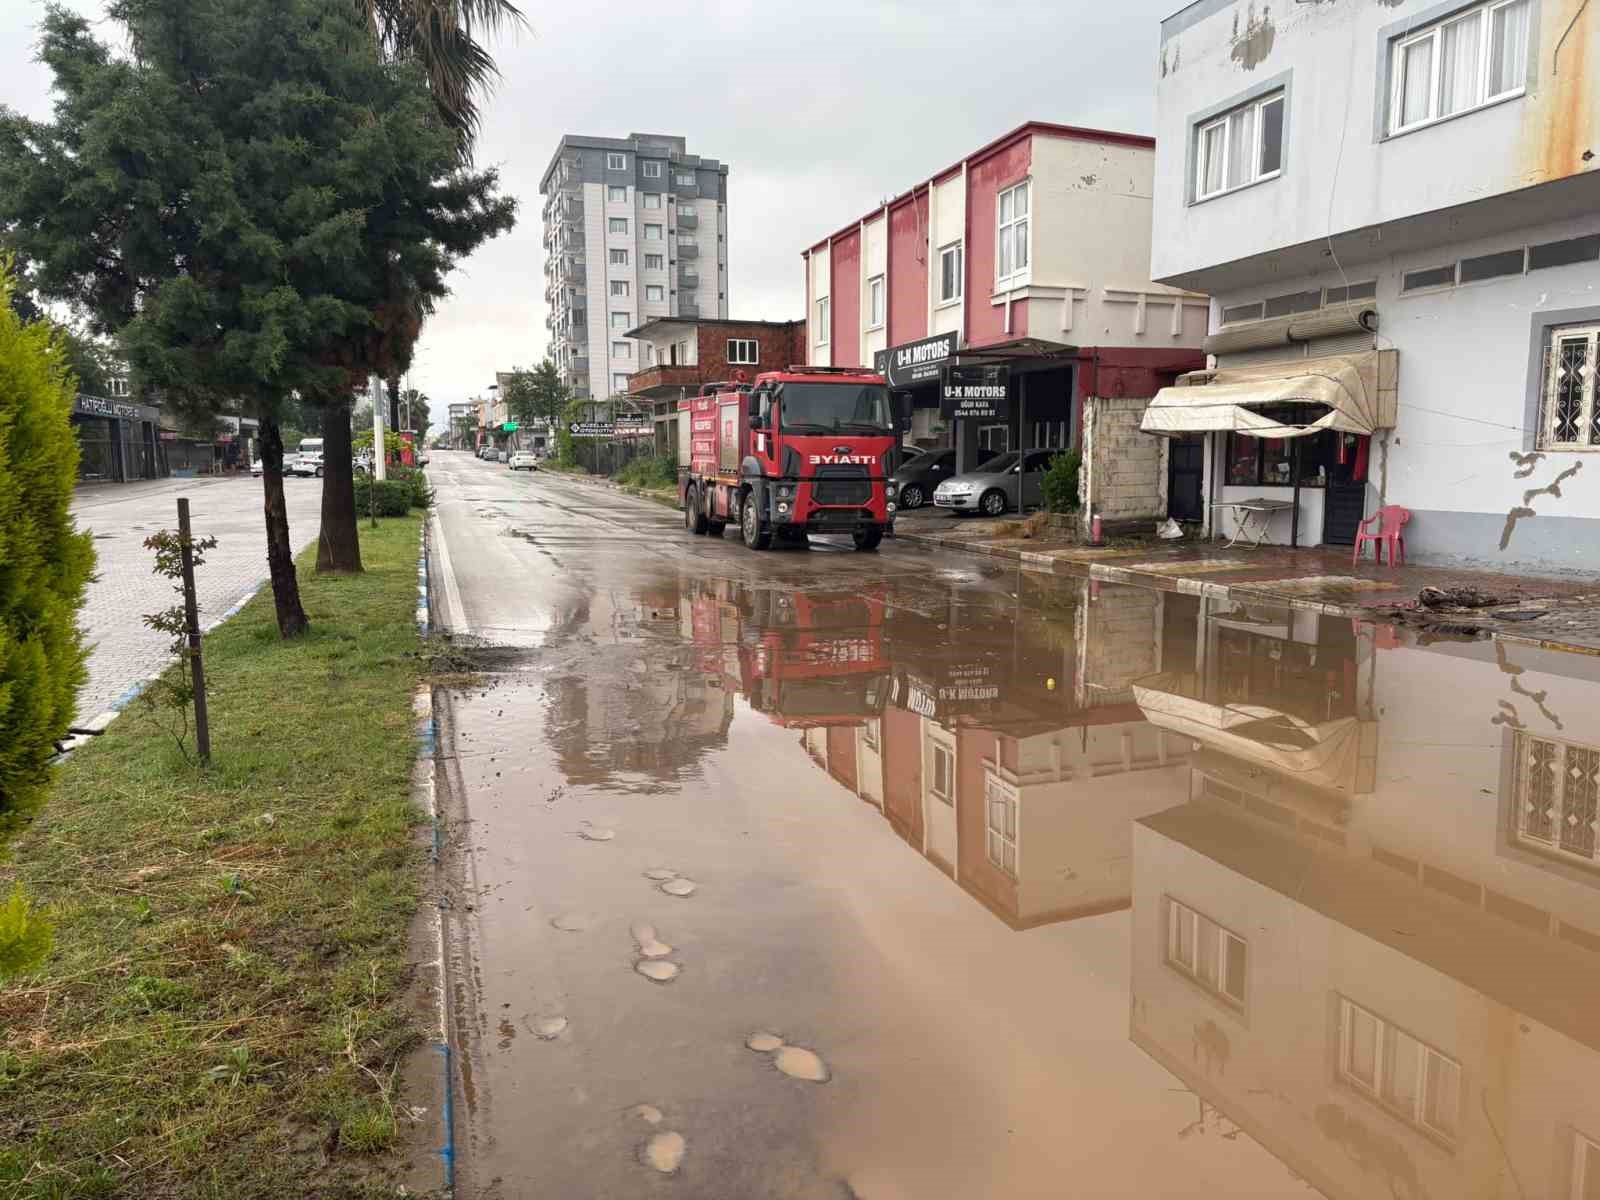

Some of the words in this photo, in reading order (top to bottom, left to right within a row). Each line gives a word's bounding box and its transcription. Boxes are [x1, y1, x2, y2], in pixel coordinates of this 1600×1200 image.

[897, 348, 912, 366] U-K
[912, 339, 950, 363] MOTORS
[944, 386, 963, 397] U-K
[964, 386, 1006, 397] MOTORS
